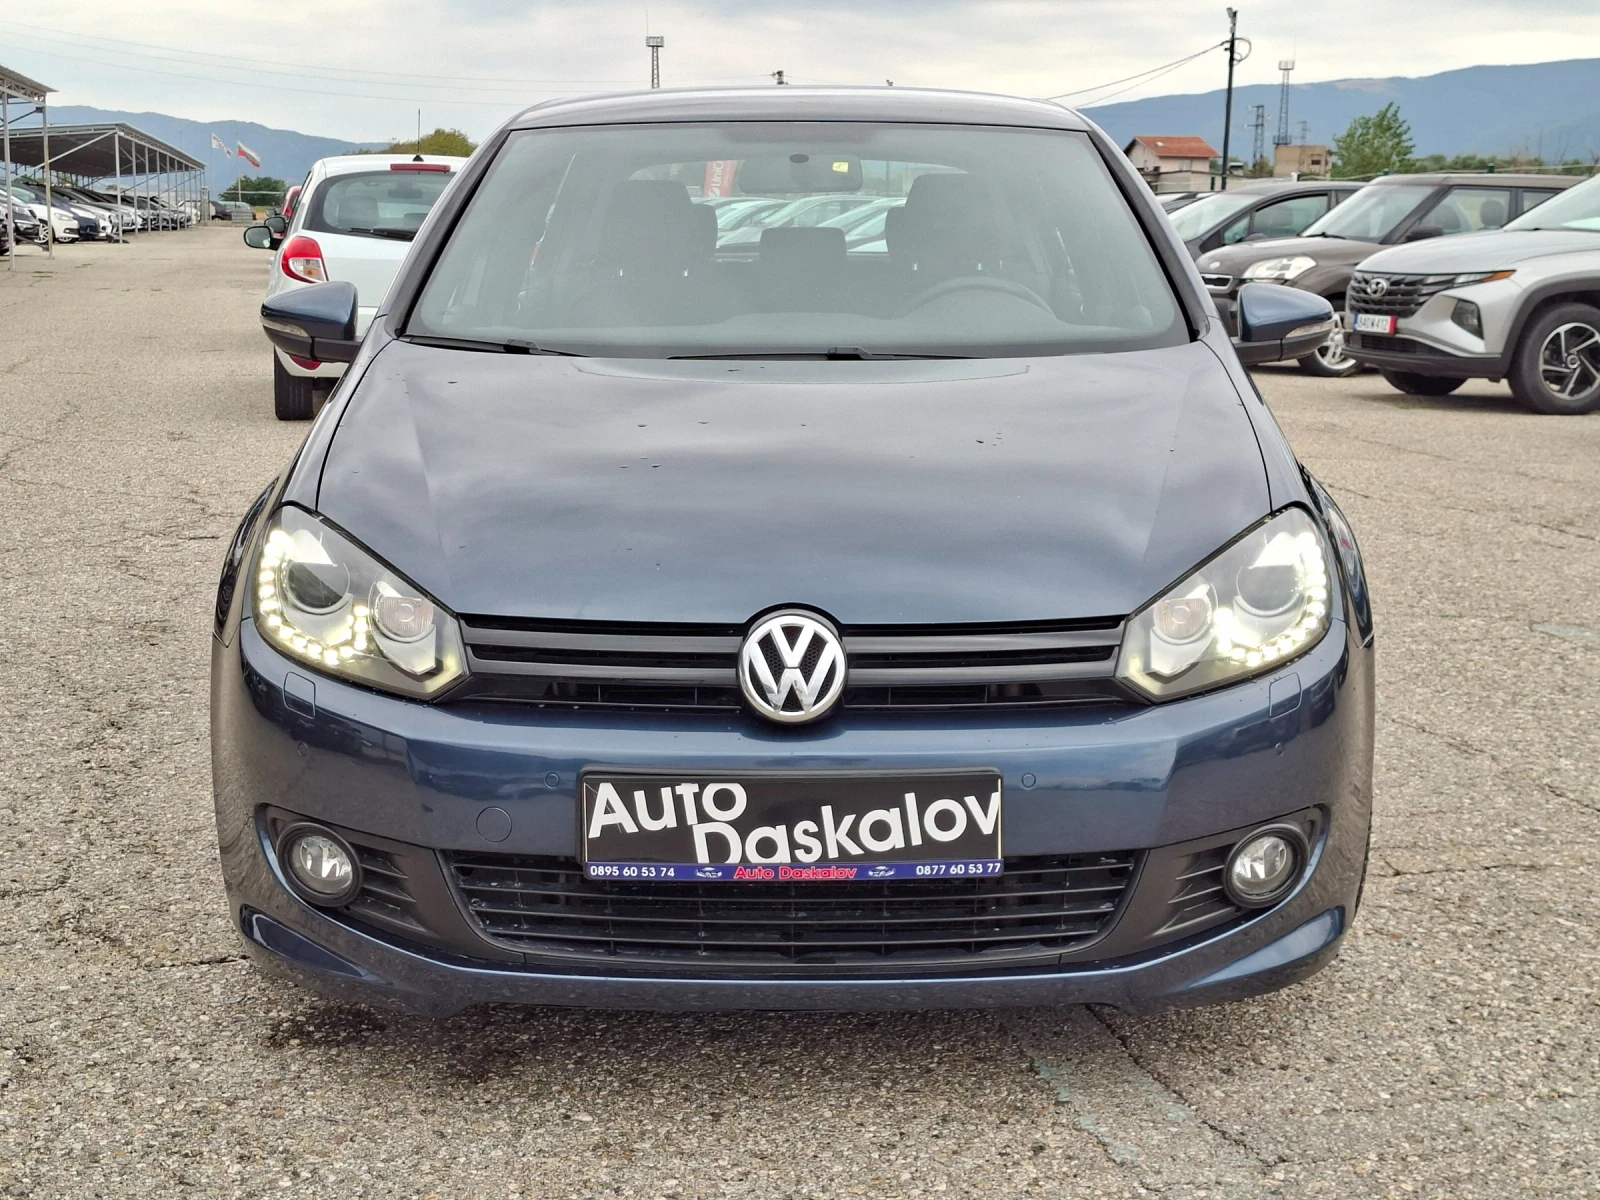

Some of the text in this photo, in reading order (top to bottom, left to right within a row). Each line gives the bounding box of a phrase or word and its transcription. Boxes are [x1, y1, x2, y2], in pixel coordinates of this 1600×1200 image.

[588, 782, 747, 839] Auto
[692, 791, 1000, 864] Daskalov
[590, 866, 675, 878] 0895 60 53 74
[733, 866, 858, 880] Auto Daskalov
[916, 863, 1001, 876] 0877 60 53 77
